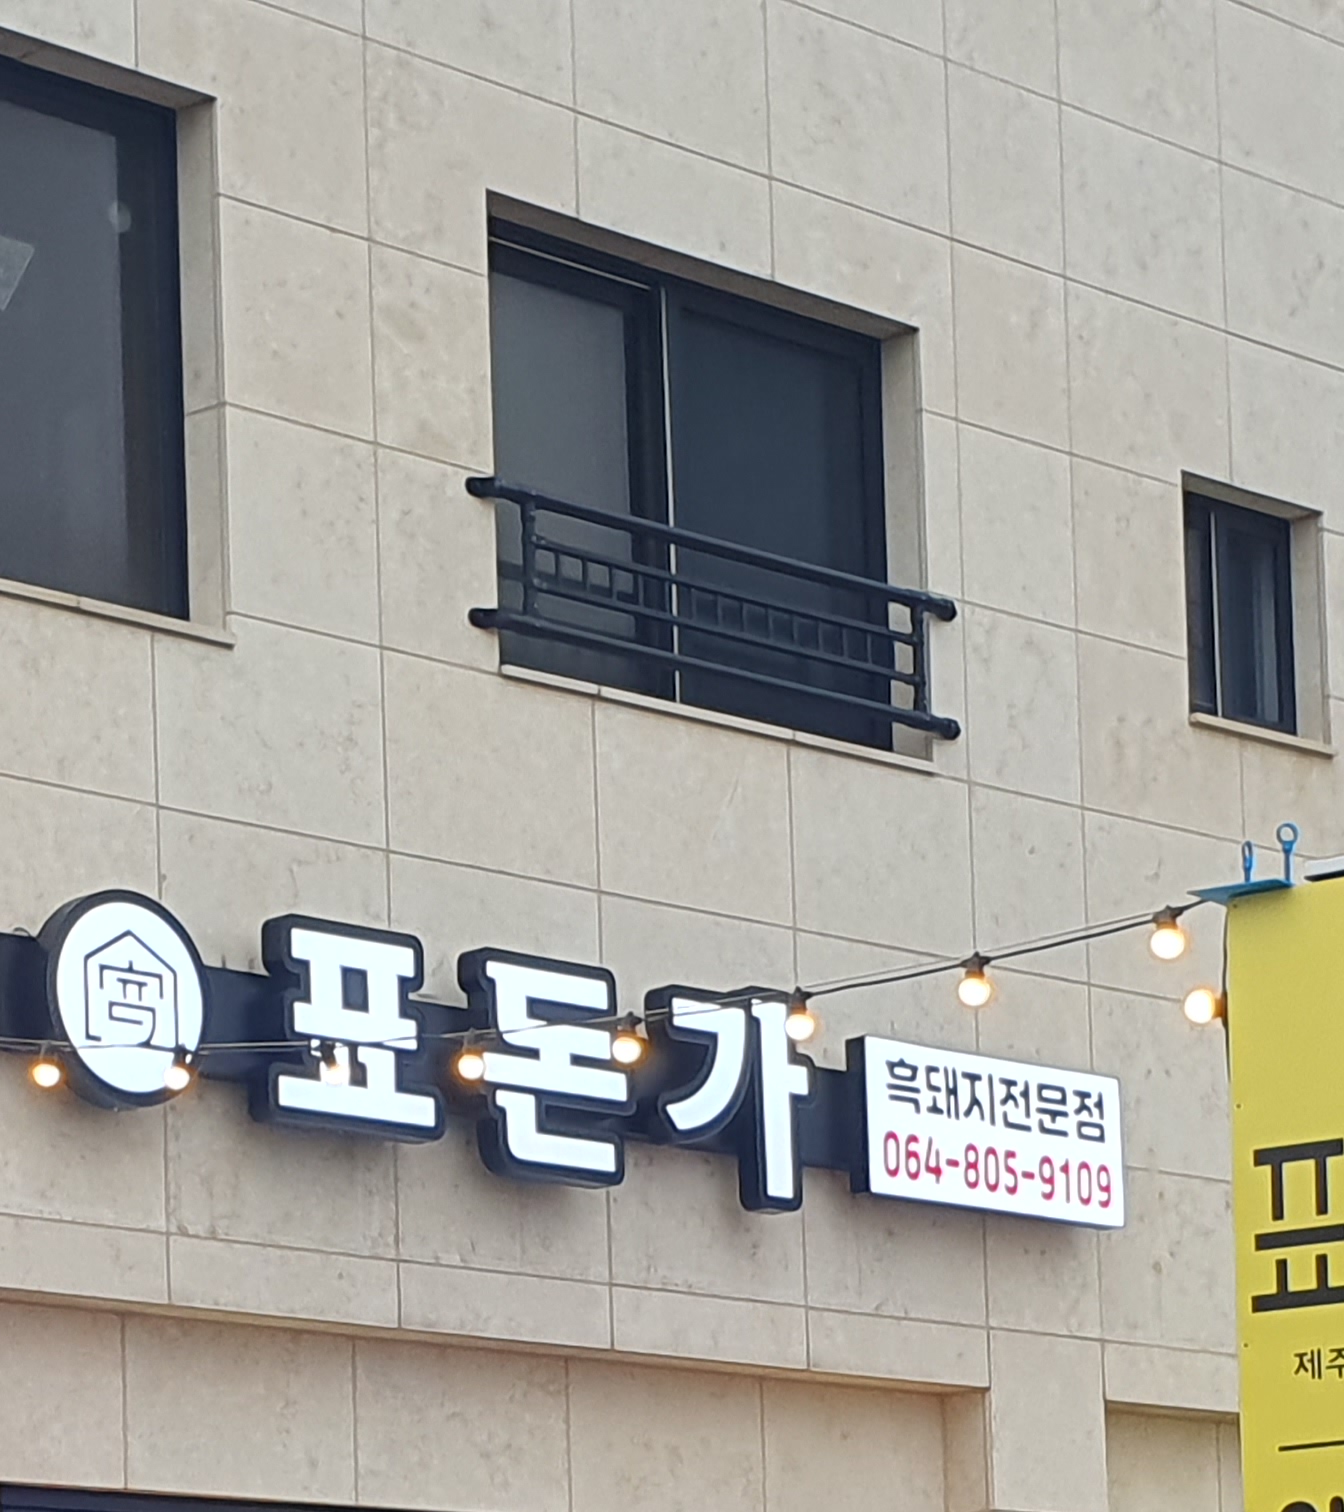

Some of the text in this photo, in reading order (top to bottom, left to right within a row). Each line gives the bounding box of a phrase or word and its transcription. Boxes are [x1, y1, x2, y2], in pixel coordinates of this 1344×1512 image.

[278, 928, 810, 1200] 표돈가
[885, 1057, 1106, 1144] 흑돼지전문점
[883, 1130, 1112, 1209] 064-805-9109
